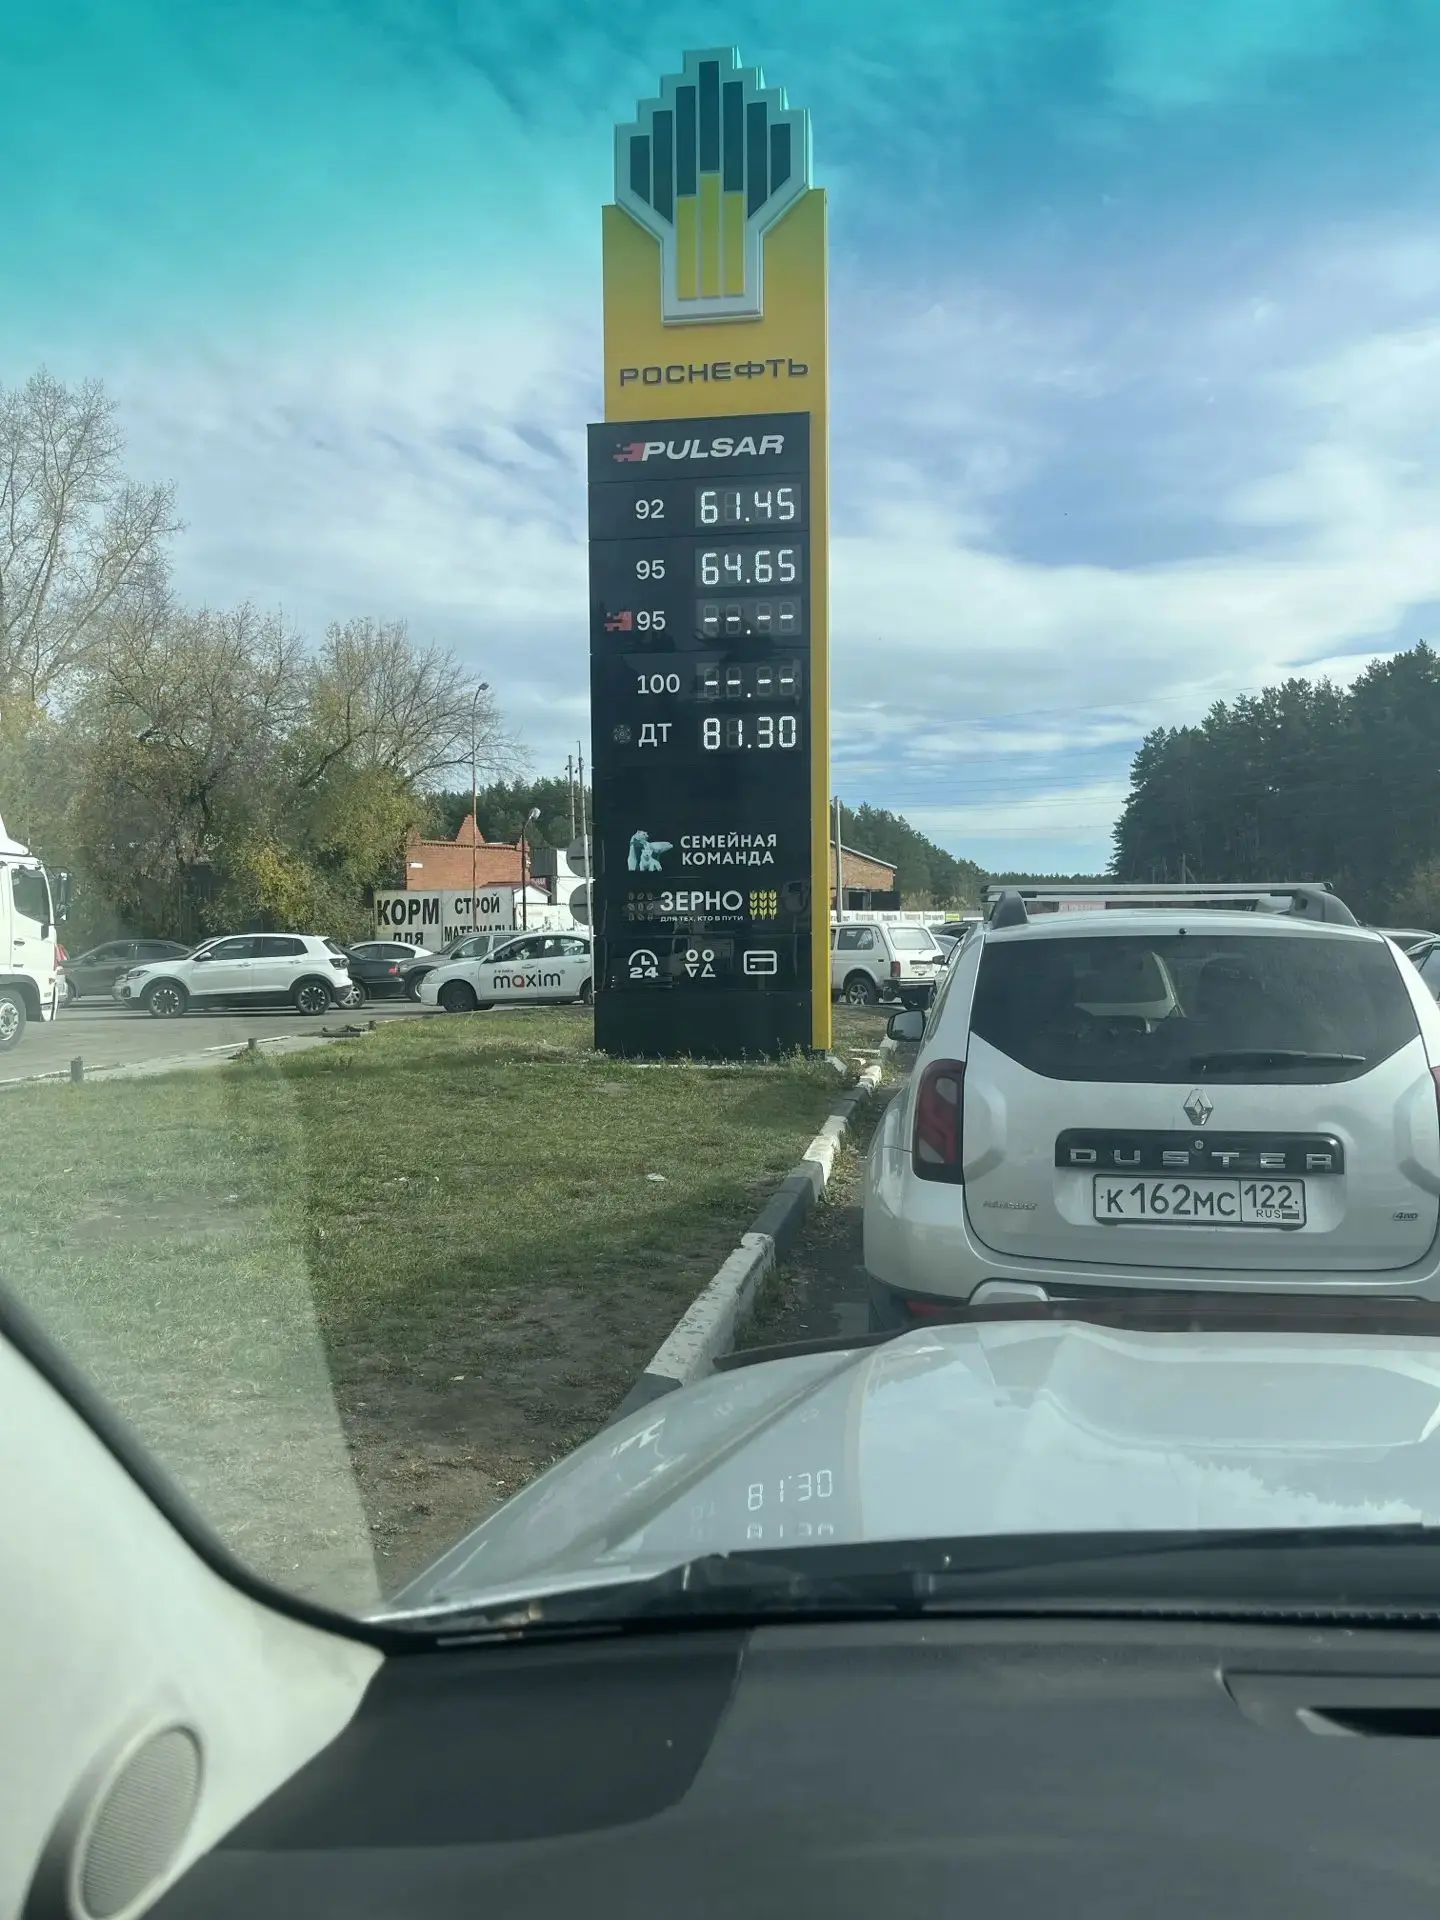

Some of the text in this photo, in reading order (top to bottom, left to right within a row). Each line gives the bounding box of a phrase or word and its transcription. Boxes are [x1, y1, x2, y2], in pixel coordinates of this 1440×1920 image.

[620, 359, 808, 386] РОСНЕФТЬ
[641, 434, 785, 462] PULSAR
[635, 487, 795, 524] 92 61.45
[636, 549, 796, 585] 95 64.65
[636, 611, 666, 631] 95
[637, 673, 680, 694] 100
[638, 715, 796, 750] ДТ 81.30
[680, 832, 777, 848] СЕМЕЙНАЯ
[682, 851, 774, 866] КОМАНДА
[454, 893, 500, 915] СТРОЙ
[660, 890, 743, 911] ЗЕРНО
[377, 898, 439, 925] КОРМ
[493, 969, 561, 989] maxim
[630, 967, 659, 979] 24
[1070, 1148, 1332, 1169] DUSTER
[1107, 1182, 1293, 1216] К162МС 122
[1256, 1209, 1281, 1218] RUS
